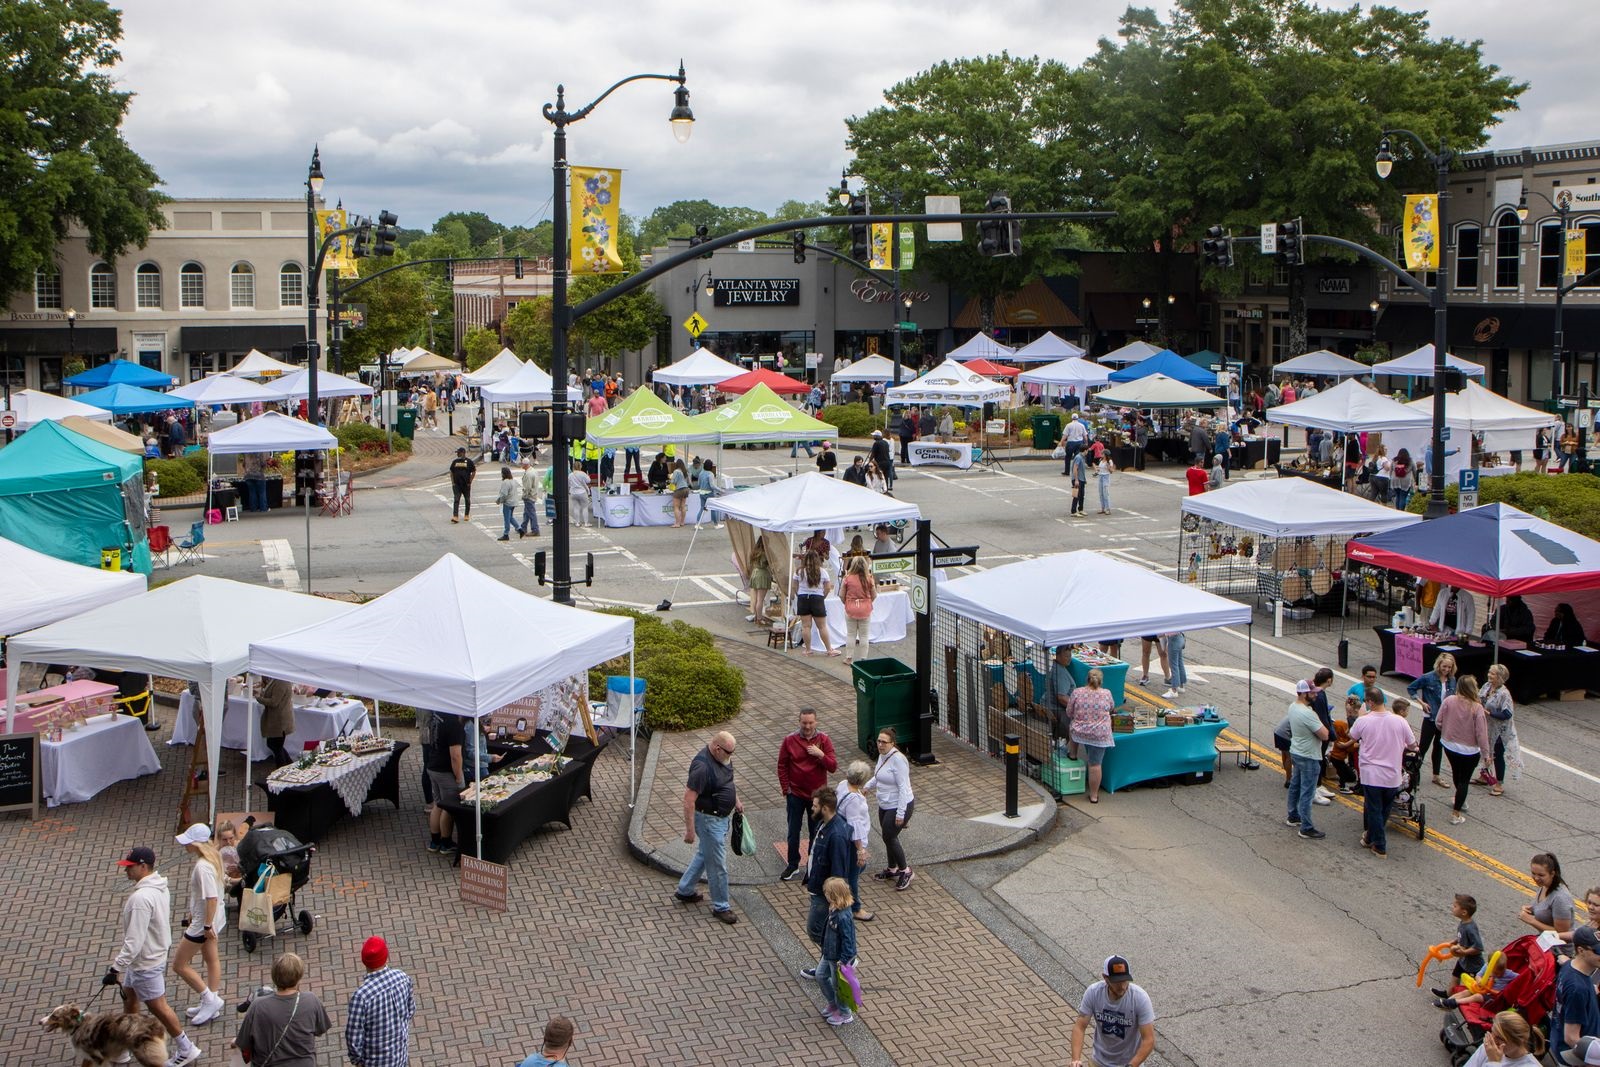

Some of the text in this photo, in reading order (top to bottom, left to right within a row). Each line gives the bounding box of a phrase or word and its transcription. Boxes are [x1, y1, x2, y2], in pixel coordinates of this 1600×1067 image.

[716, 280, 798, 290] ATLANTA WEST
[1320, 279, 1348, 292] NAMA
[726, 290, 789, 306] JEWELRY
[1236, 309, 1263, 318] Pita Pit
[921, 452, 957, 461] Classics
[1464, 471, 1475, 487] P
[876, 562, 890, 570] EXIT
[3, 743, 18, 753] The
[463, 857, 504, 877] HANDMADE
[464, 870, 502, 889] CLAY EARRINGS
[1095, 1012, 1133, 1025] CHAMPIONS
